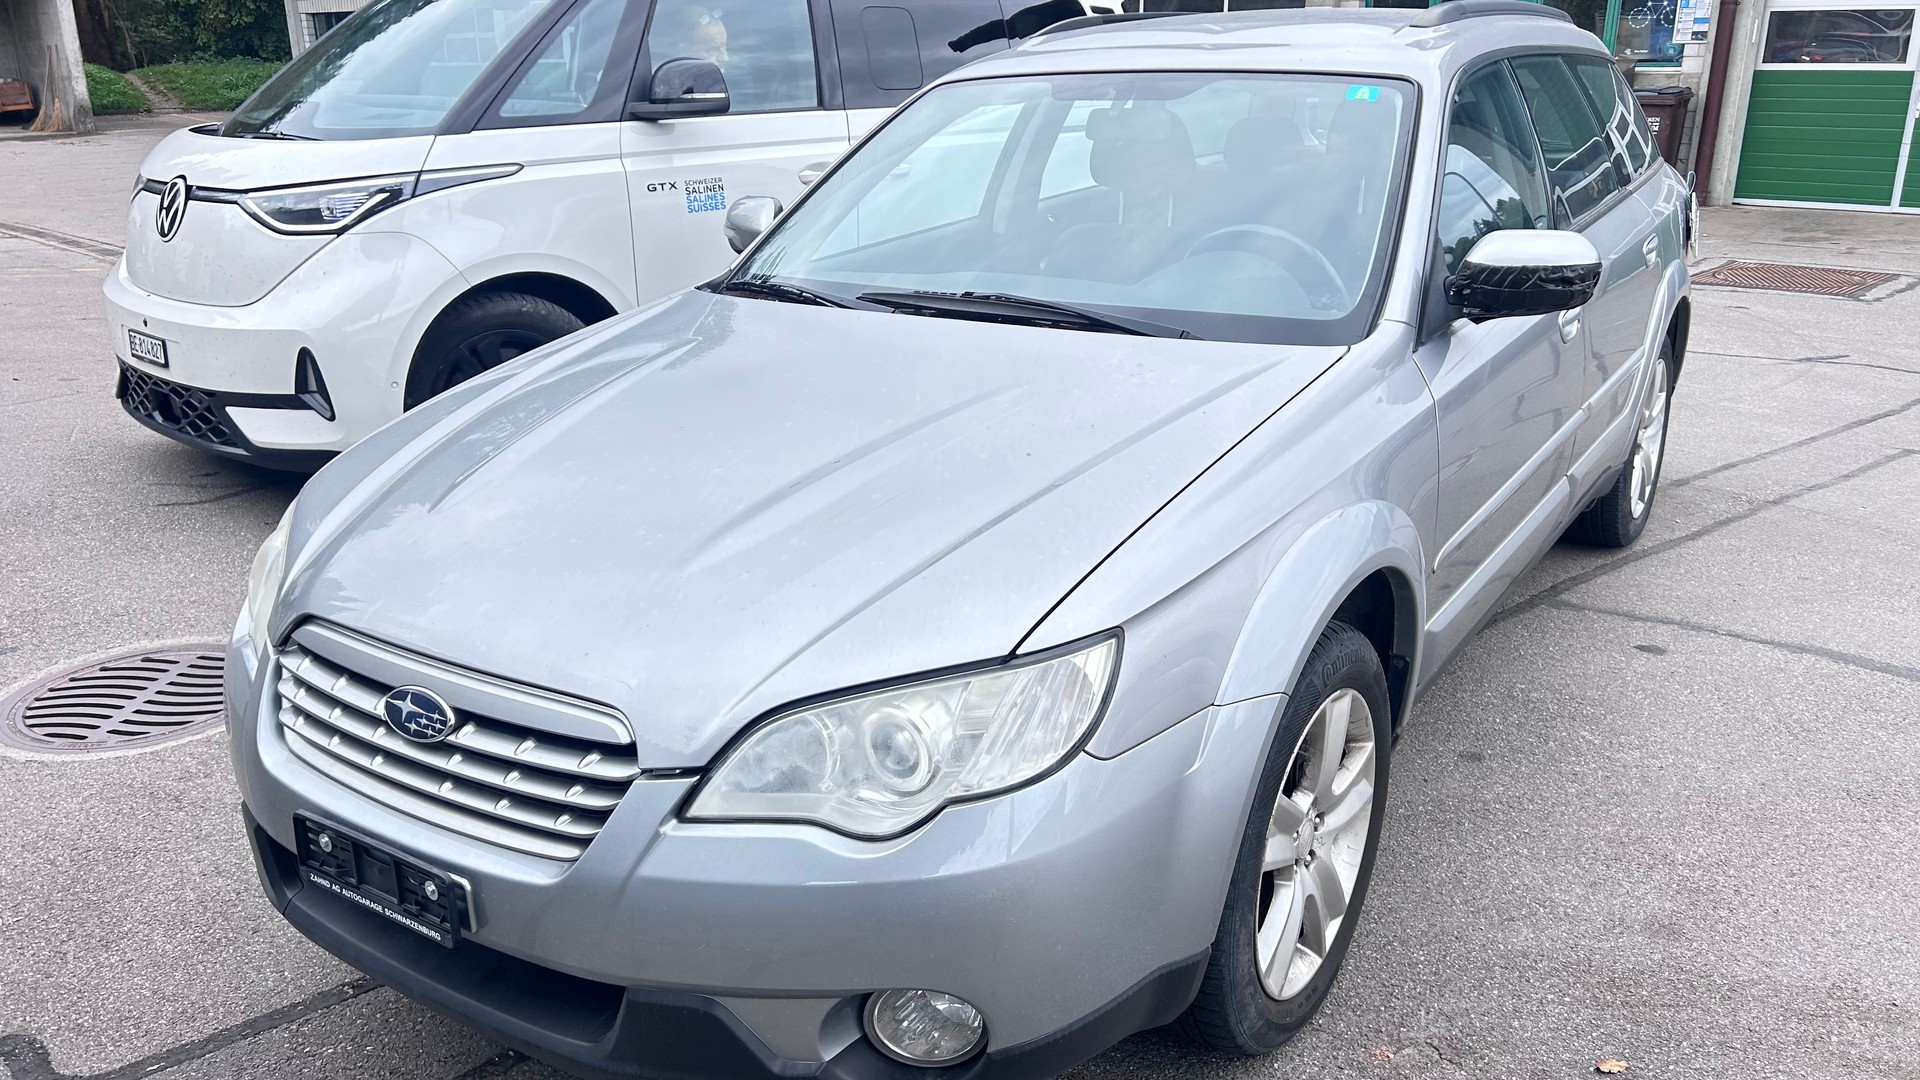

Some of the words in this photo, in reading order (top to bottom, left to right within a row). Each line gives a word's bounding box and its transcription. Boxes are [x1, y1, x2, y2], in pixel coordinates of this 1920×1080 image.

[647, 181, 678, 193] GTX
[684, 177, 723, 187] SCHWEIZER
[685, 184, 724, 196] SALINEN
[686, 192, 726, 204] SALINES
[687, 201, 727, 213] SUISSES
[310, 873, 331, 888] ZAHND
[332, 883, 341, 893] AG
[342, 888, 384, 914] AUTOGARAGE
[384, 907, 442, 941] SCHWARZENBURG
